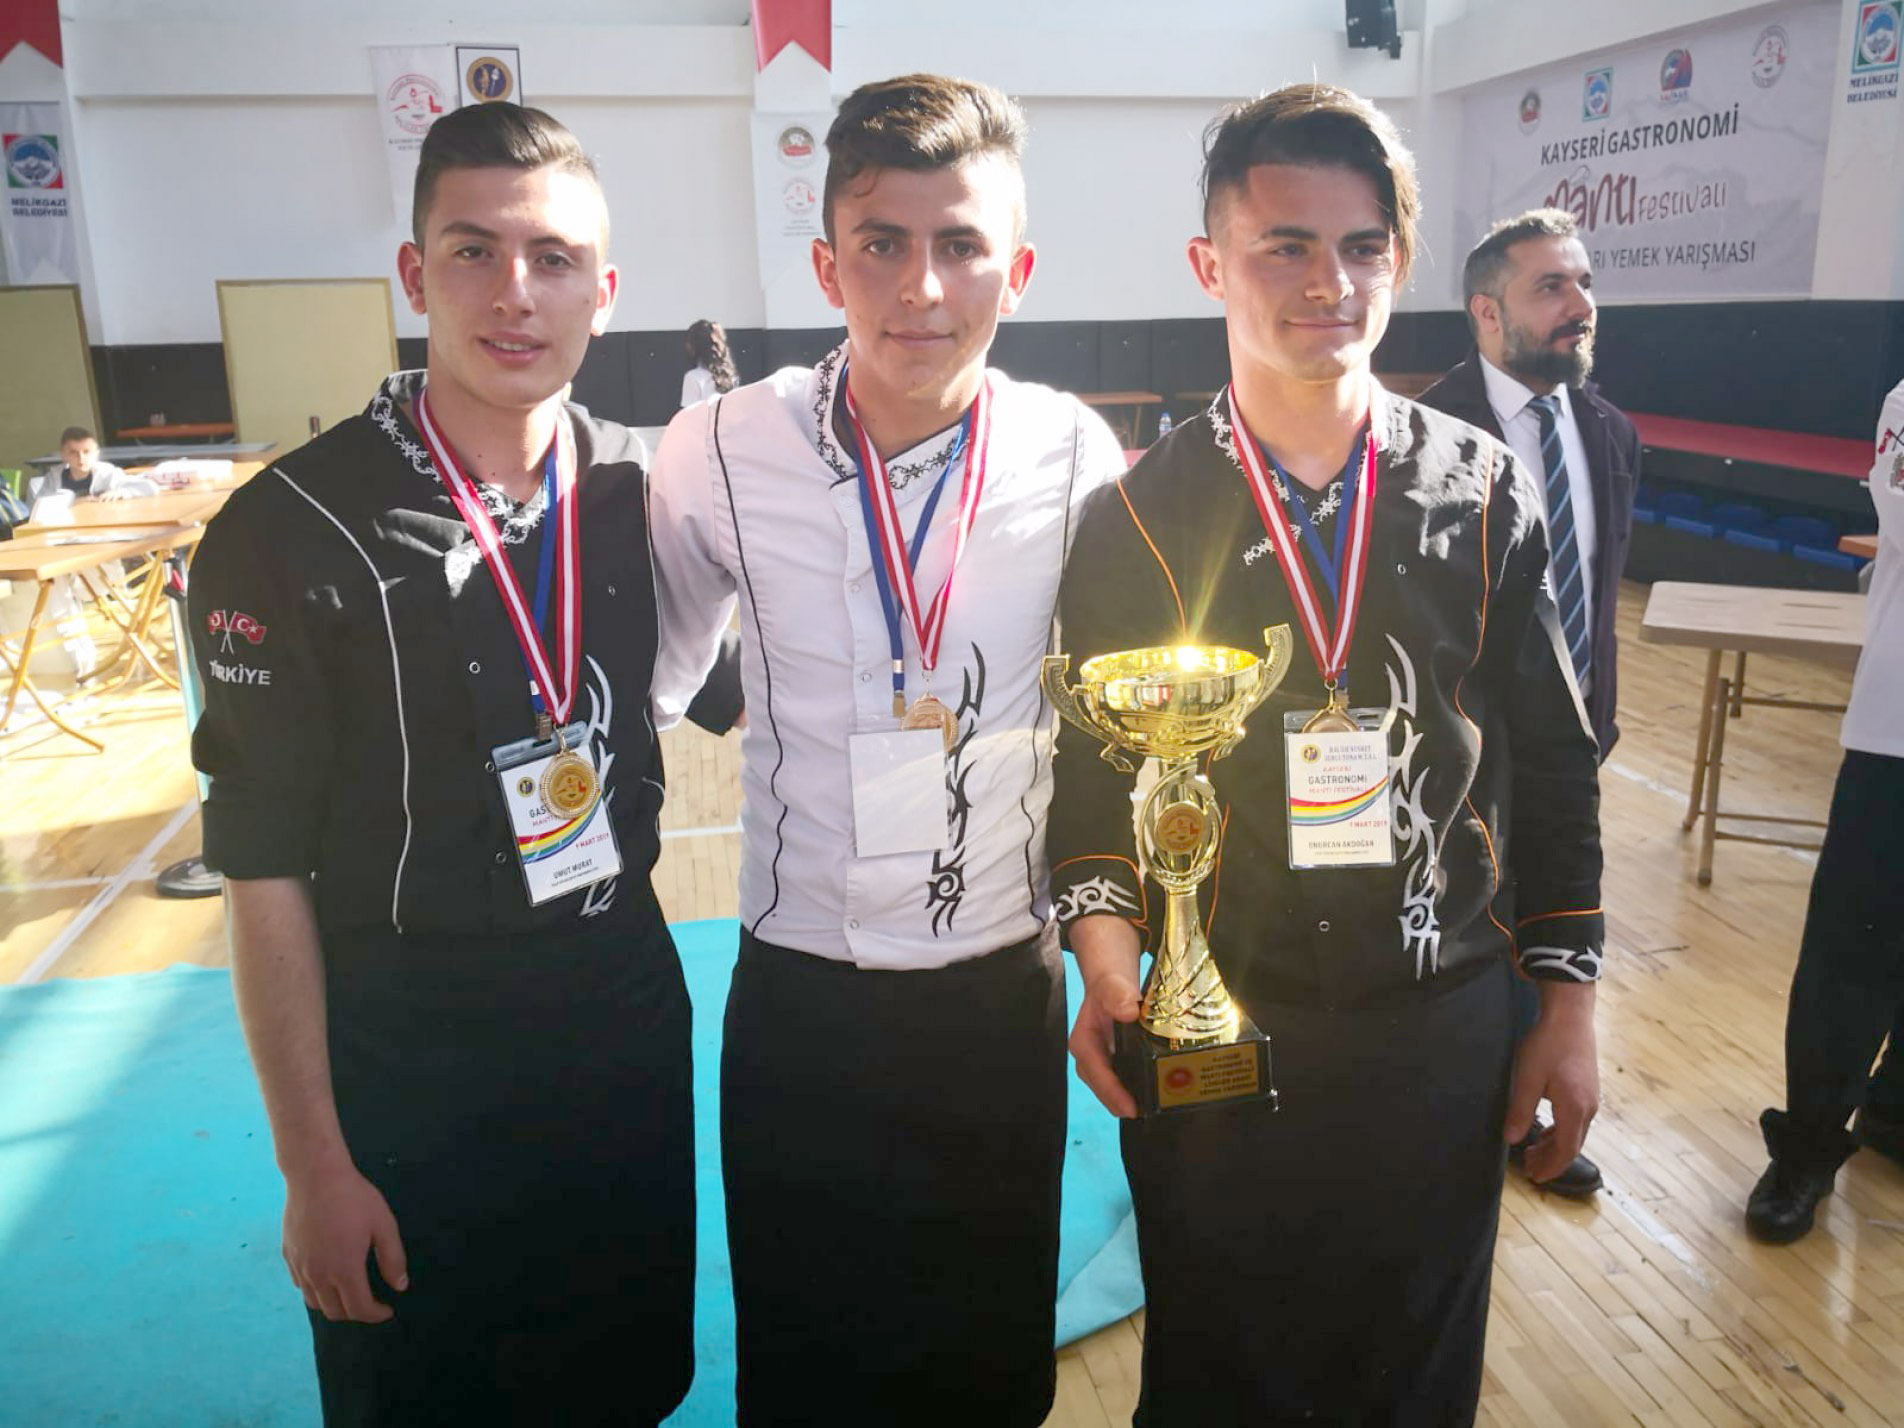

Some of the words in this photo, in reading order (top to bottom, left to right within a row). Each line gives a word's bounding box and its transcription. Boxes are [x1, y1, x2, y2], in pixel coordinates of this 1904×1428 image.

[1540, 128, 1605, 166] KAYSERİ
[1607, 102, 1740, 155] GASTRONOMİ
[1610, 246, 1660, 268] YEMEK
[1665, 240, 1756, 270] YARIŞMASI
